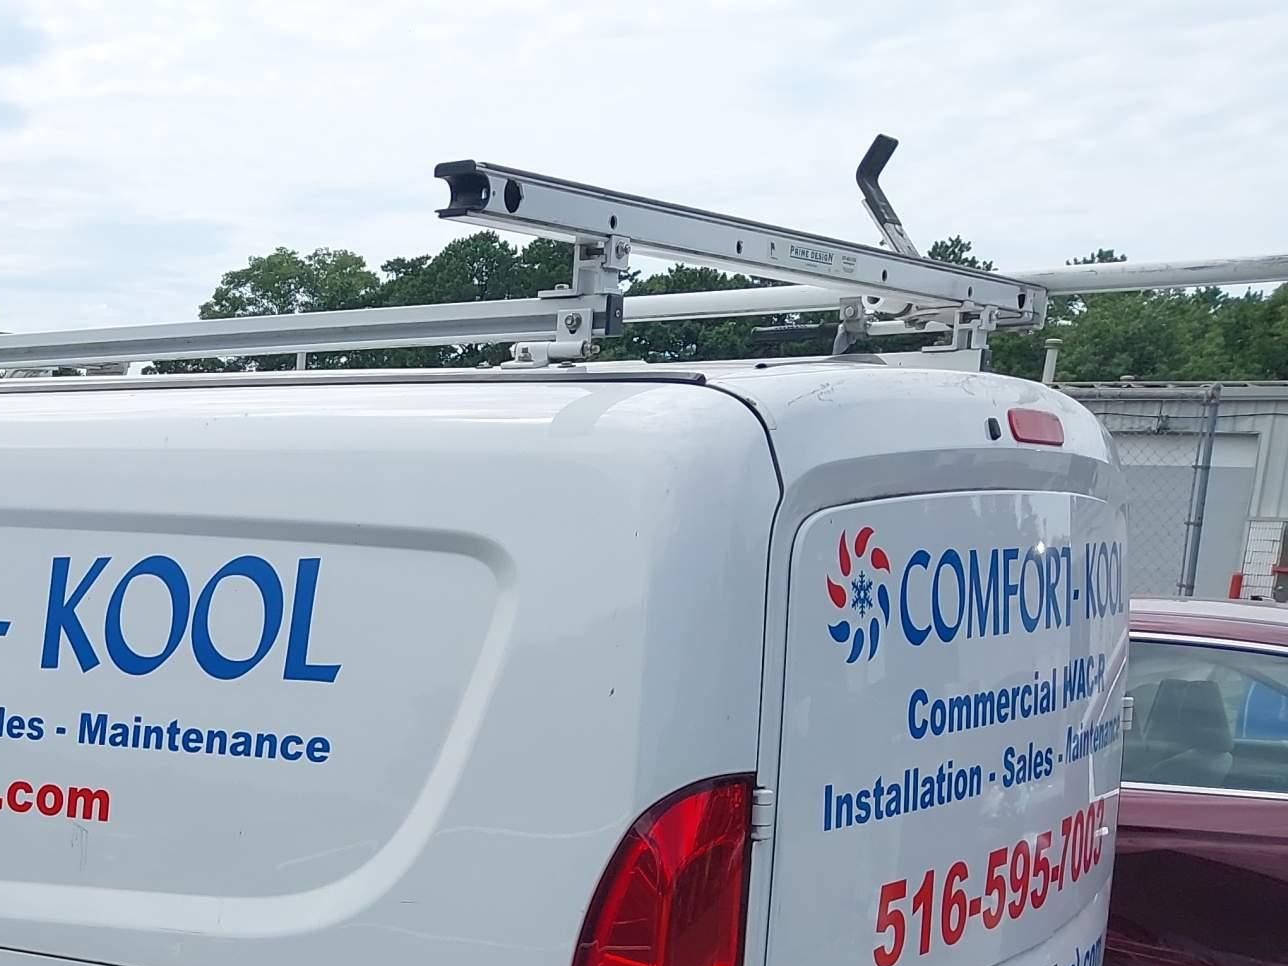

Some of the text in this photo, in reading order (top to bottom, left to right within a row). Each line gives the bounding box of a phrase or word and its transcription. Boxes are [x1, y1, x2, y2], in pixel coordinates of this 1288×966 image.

[41, 555, 342, 682] KOOL
[900, 546, 1071, 646] COMFORT
[1085, 541, 1124, 619] KOOL
[78, 712, 331, 763] Maintenance
[908, 653, 1105, 740] Commercial HVAC-R
[823, 760, 982, 831] Installation
[1003, 742, 1053, 788] Sales
